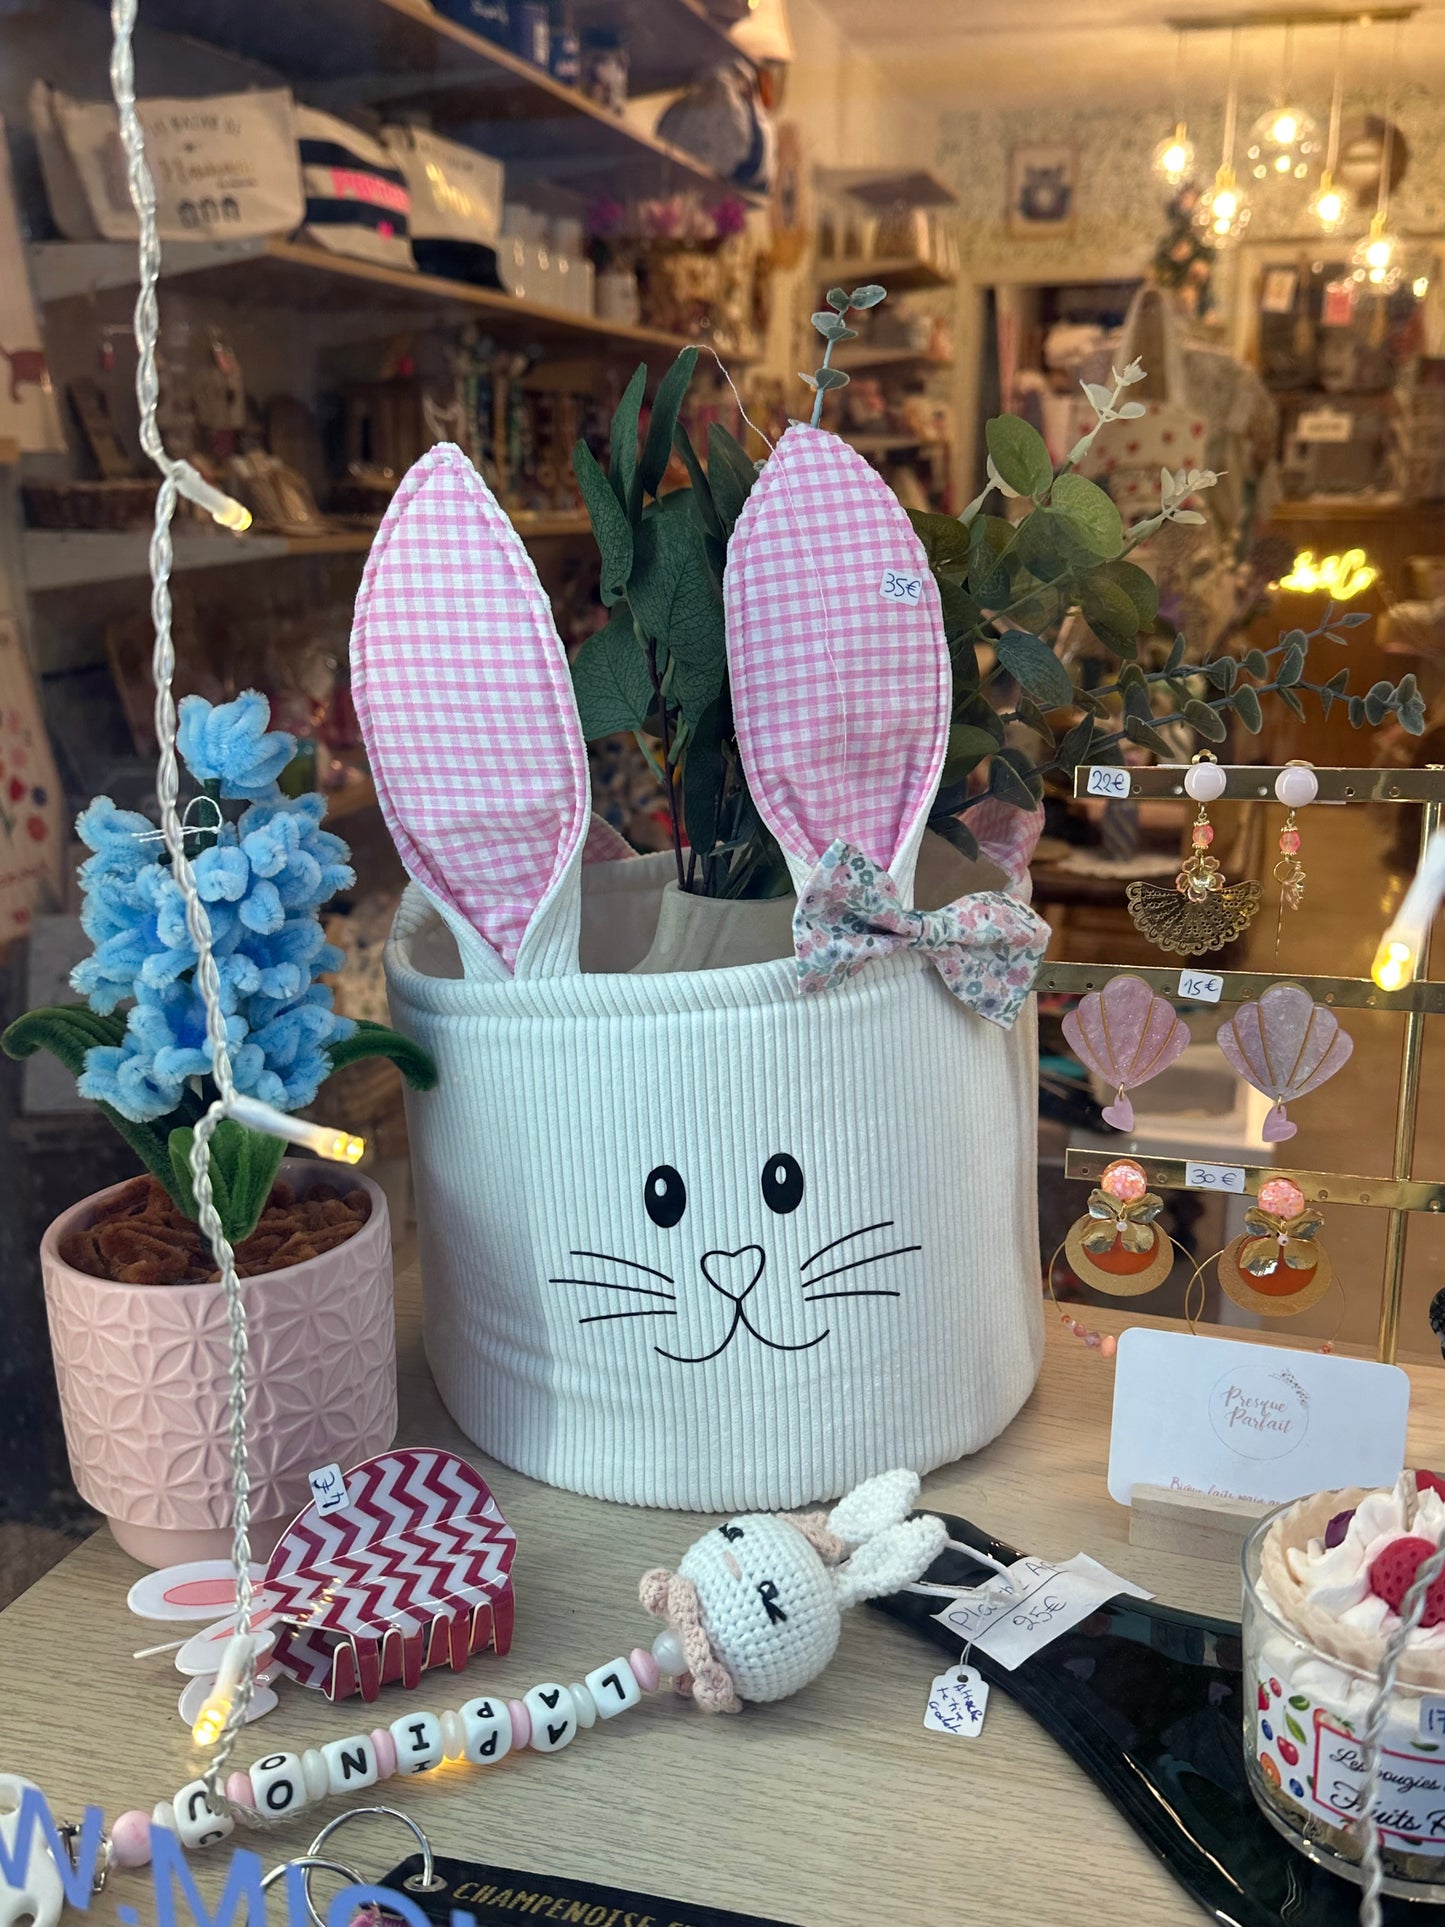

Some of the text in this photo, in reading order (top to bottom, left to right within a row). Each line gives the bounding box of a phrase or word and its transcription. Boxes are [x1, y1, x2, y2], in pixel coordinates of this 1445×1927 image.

[885, 572, 921, 599] 35€
[1092, 770, 1126, 793] 22€
[1220, 1385, 1287, 1417] Presque
[1224, 1405, 1293, 1433] Parfait
[313, 1471, 345, 1508] 4€
[1012, 1595, 1067, 1631] 25€
[1329, 1748, 1368, 1774] Les
